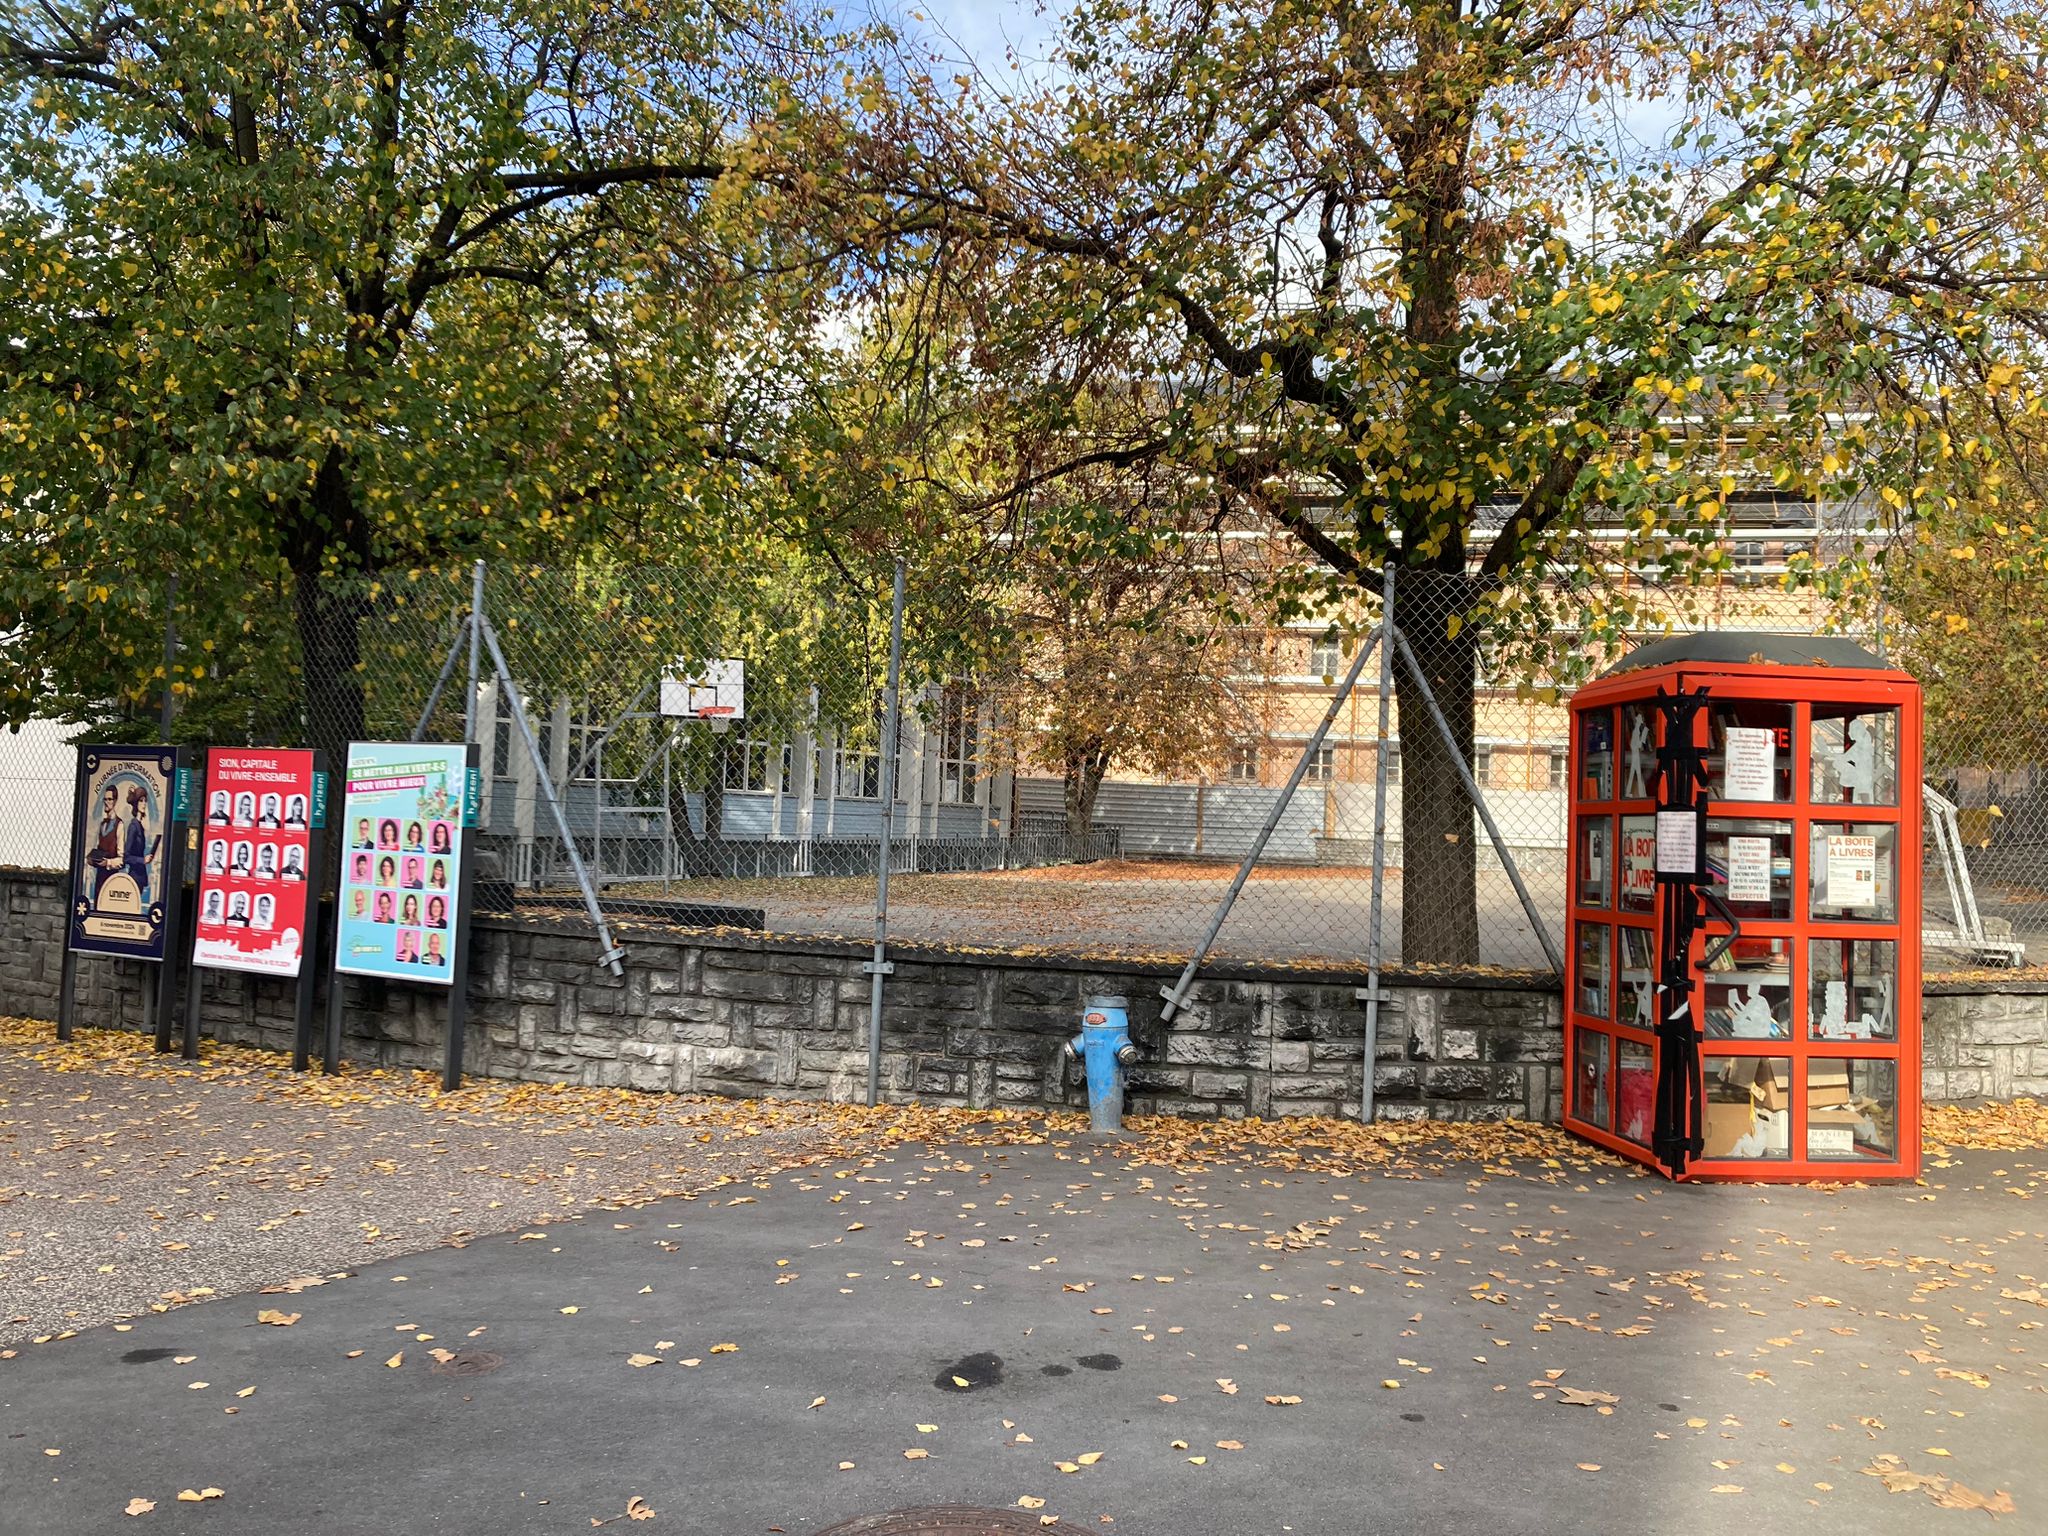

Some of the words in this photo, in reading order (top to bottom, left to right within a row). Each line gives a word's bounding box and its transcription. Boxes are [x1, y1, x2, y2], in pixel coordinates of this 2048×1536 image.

[219, 758, 240, 769] SION,
[241, 759, 278, 770] CAPITALE
[94, 765, 118, 794] JOURNÉE
[219, 770, 230, 780] DU
[230, 771, 297, 783] VIVRE-ENSEMBLE
[1829, 837, 1842, 845] LA
[1839, 848, 1874, 857] LIVRES
